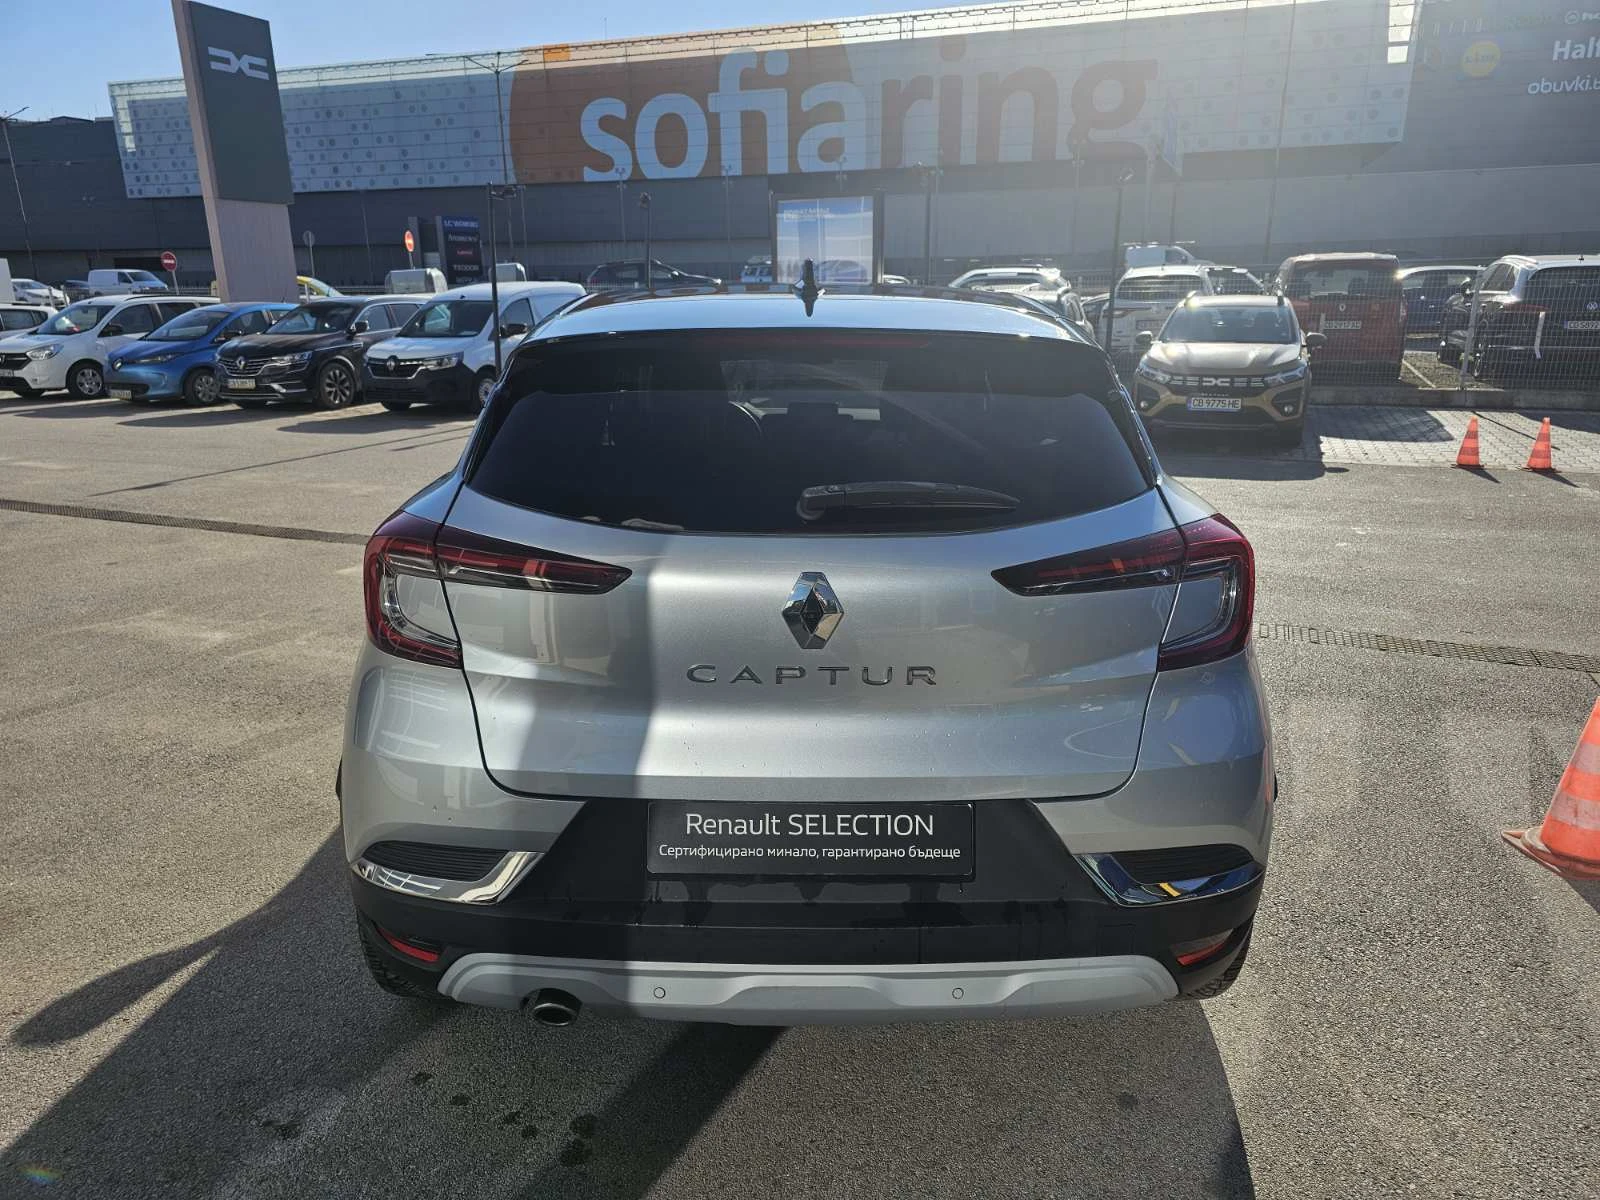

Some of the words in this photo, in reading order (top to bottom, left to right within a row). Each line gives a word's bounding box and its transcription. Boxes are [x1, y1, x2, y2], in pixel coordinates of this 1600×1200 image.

[580, 33, 1160, 181] sofiaring
[686, 664, 937, 686] CAPTUR
[685, 812, 781, 835] Renault
[788, 813, 934, 836] SELECTION
[659, 844, 764, 859] Сертифицирано
[767, 847, 820, 860] минало,
[822, 847, 906, 860] гарантирано
[908, 845, 961, 860] бъдеще
